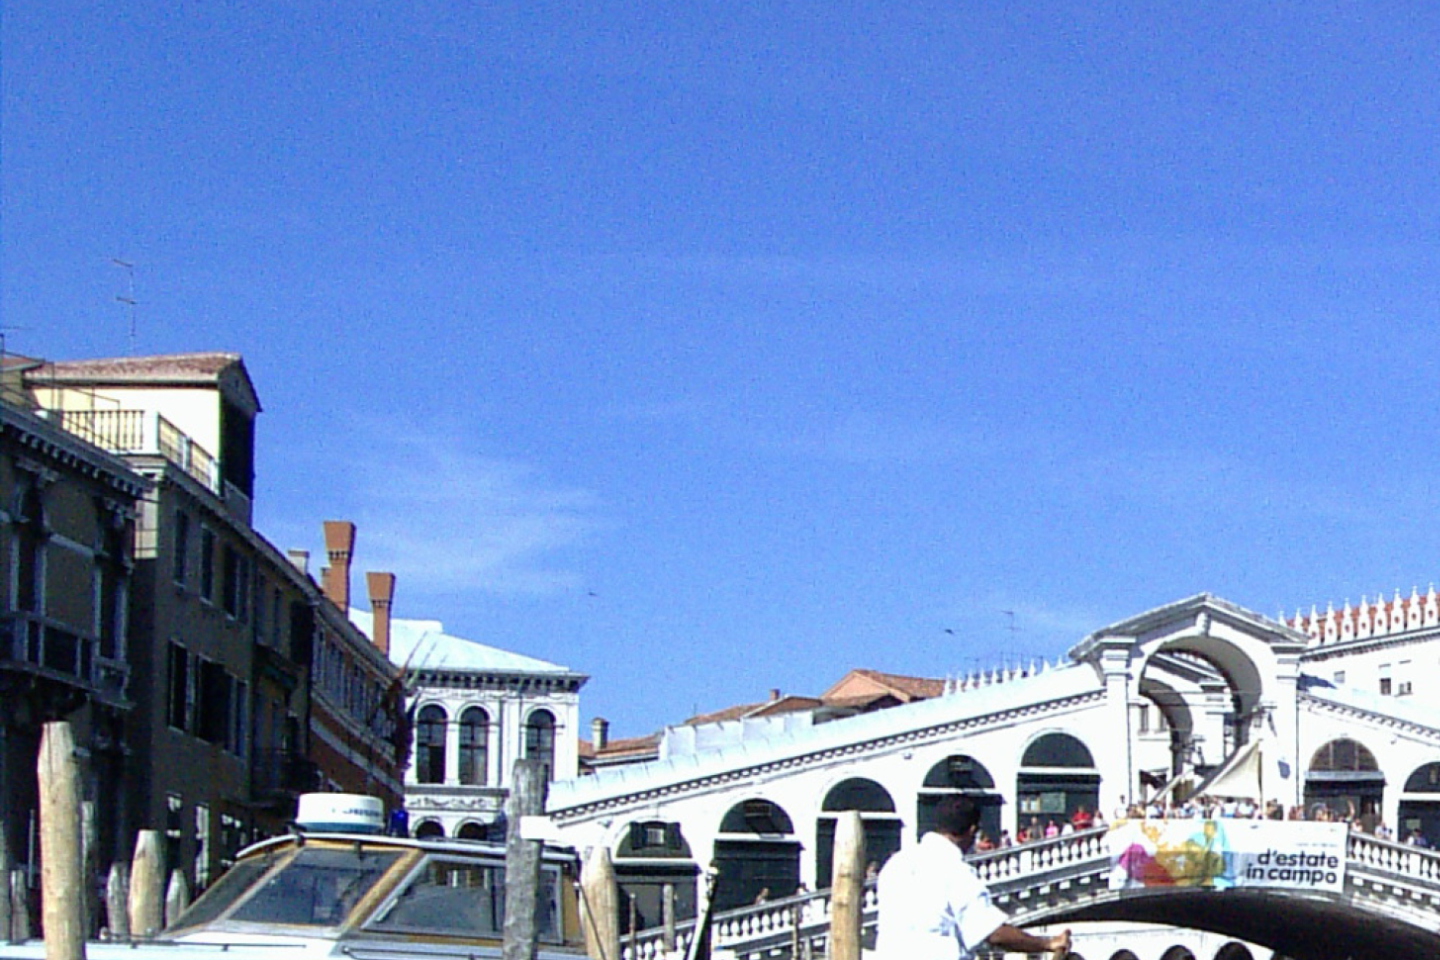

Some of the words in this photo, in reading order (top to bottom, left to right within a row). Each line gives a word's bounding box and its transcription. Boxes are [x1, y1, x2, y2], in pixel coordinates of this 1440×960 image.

[1257, 848, 1339, 868] d'estate
[1246, 863, 1264, 879] in
[1267, 867, 1337, 885] campo
